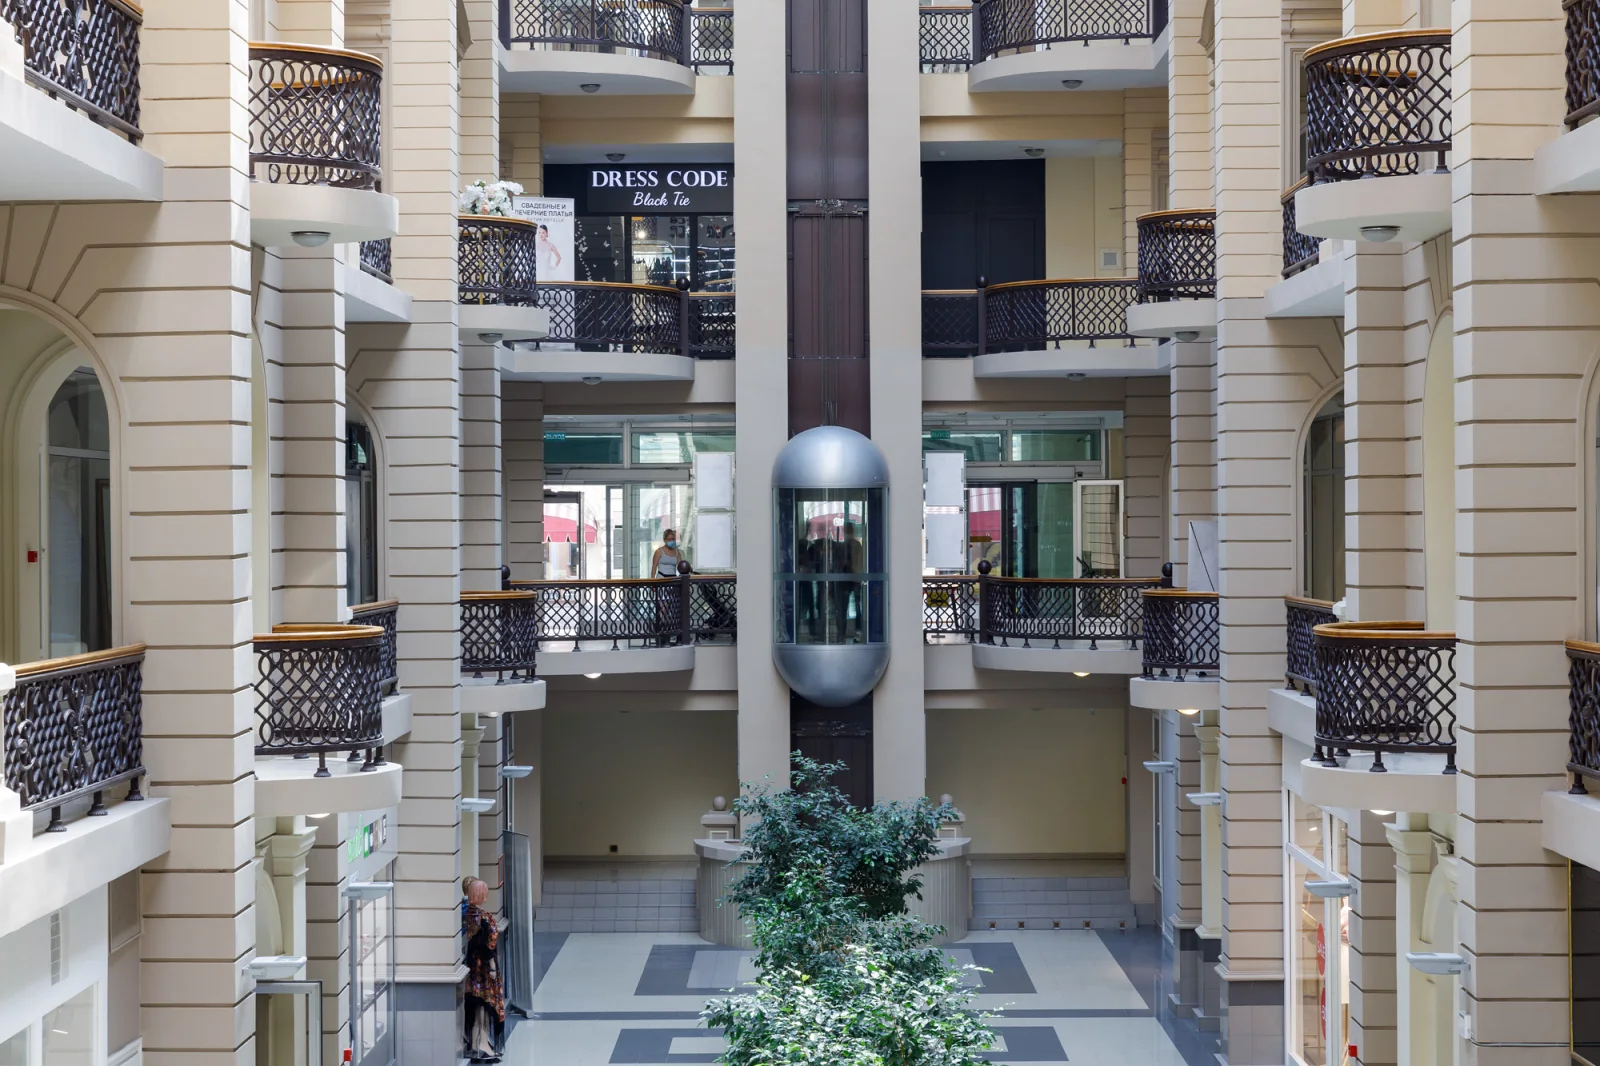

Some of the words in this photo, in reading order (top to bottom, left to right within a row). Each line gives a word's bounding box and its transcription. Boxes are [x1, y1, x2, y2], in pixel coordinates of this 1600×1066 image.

[591, 170, 659, 187] DRESS
[666, 170, 728, 187] CODE
[633, 191, 668, 206] Black
[673, 191, 691, 206] Tie
[521, 202, 560, 210] СВАДЕБНЫЕ
[548, 210, 573, 218] ПЛАТЬЯ
